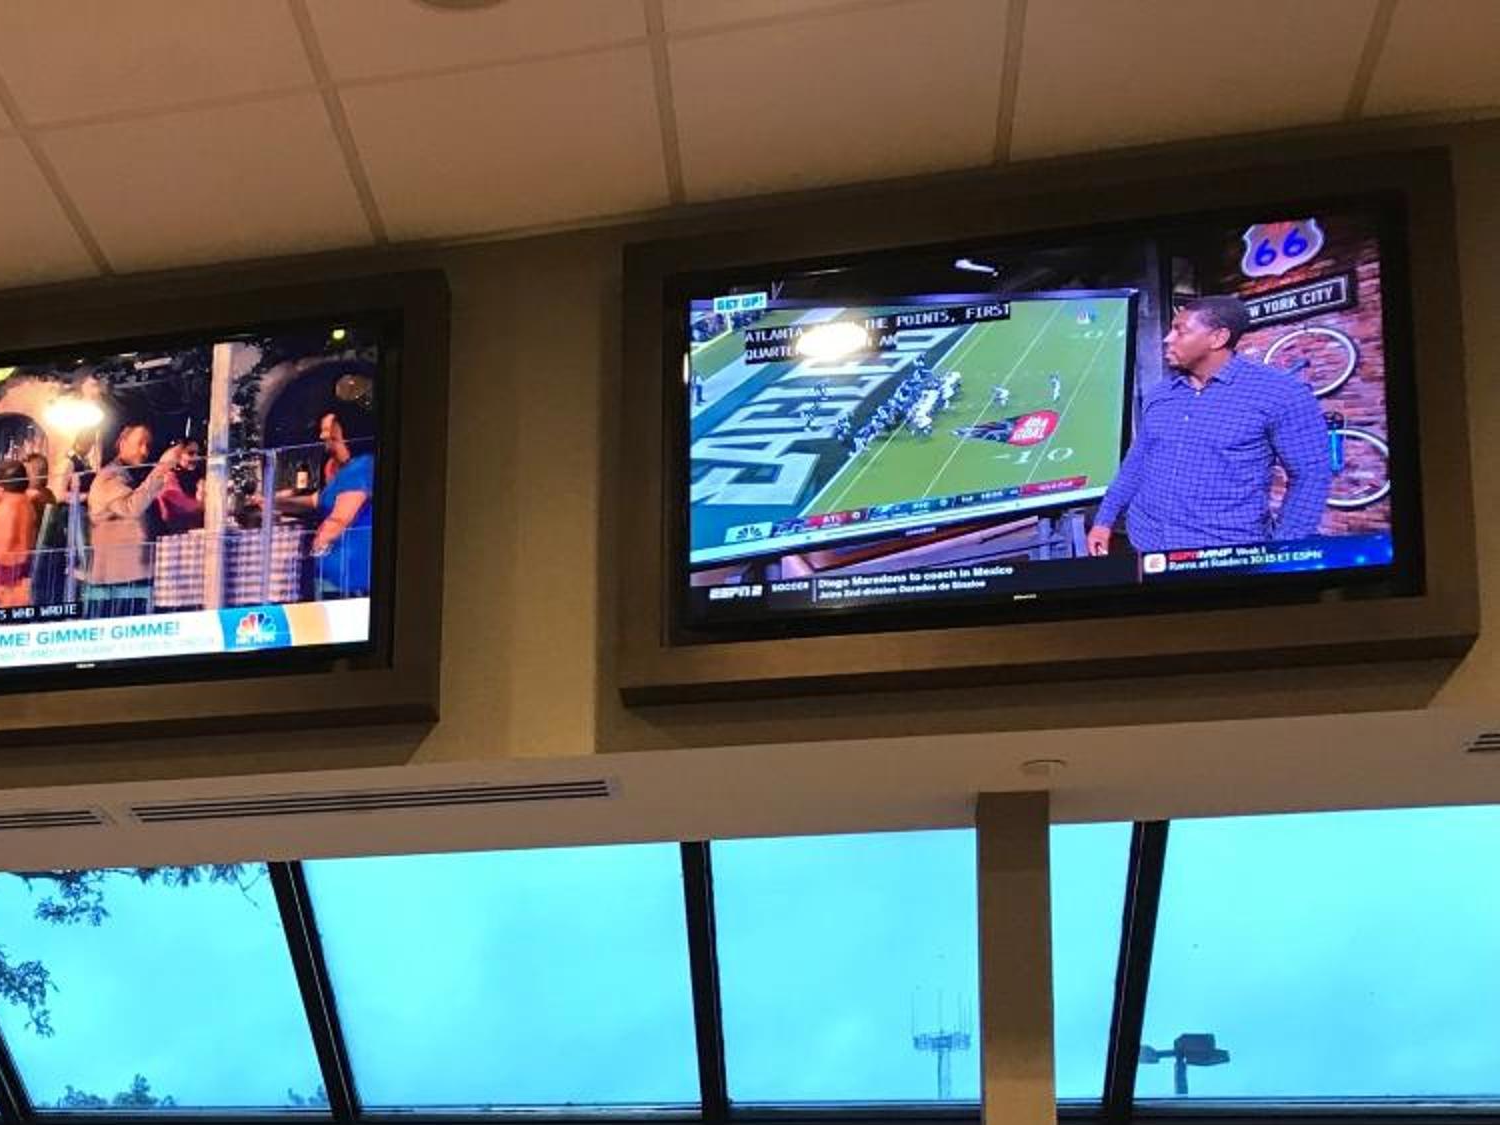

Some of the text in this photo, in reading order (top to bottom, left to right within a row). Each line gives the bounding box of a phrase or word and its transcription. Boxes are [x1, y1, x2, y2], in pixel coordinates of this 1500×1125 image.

[1254, 227, 1308, 267] 66
[717, 299, 738, 311] GET
[1264, 296, 1298, 315] YORK
[1302, 286, 1334, 306] CITY
[897, 311, 956, 328] POINTS,
[966, 302, 1010, 319] FIRST
[771, 582, 809, 594] SOCCER
[818, 576, 850, 592] Diego
[909, 572, 921, 584] to
[923, 570, 957, 582] coach
[960, 568, 970, 579] in
[973, 565, 1013, 579] Mexico
[12, 606, 35, 619] WHO
[40, 603, 78, 617] WROTE
[36, 625, 104, 645] GIMME!
[111, 620, 180, 640] GIMME!
